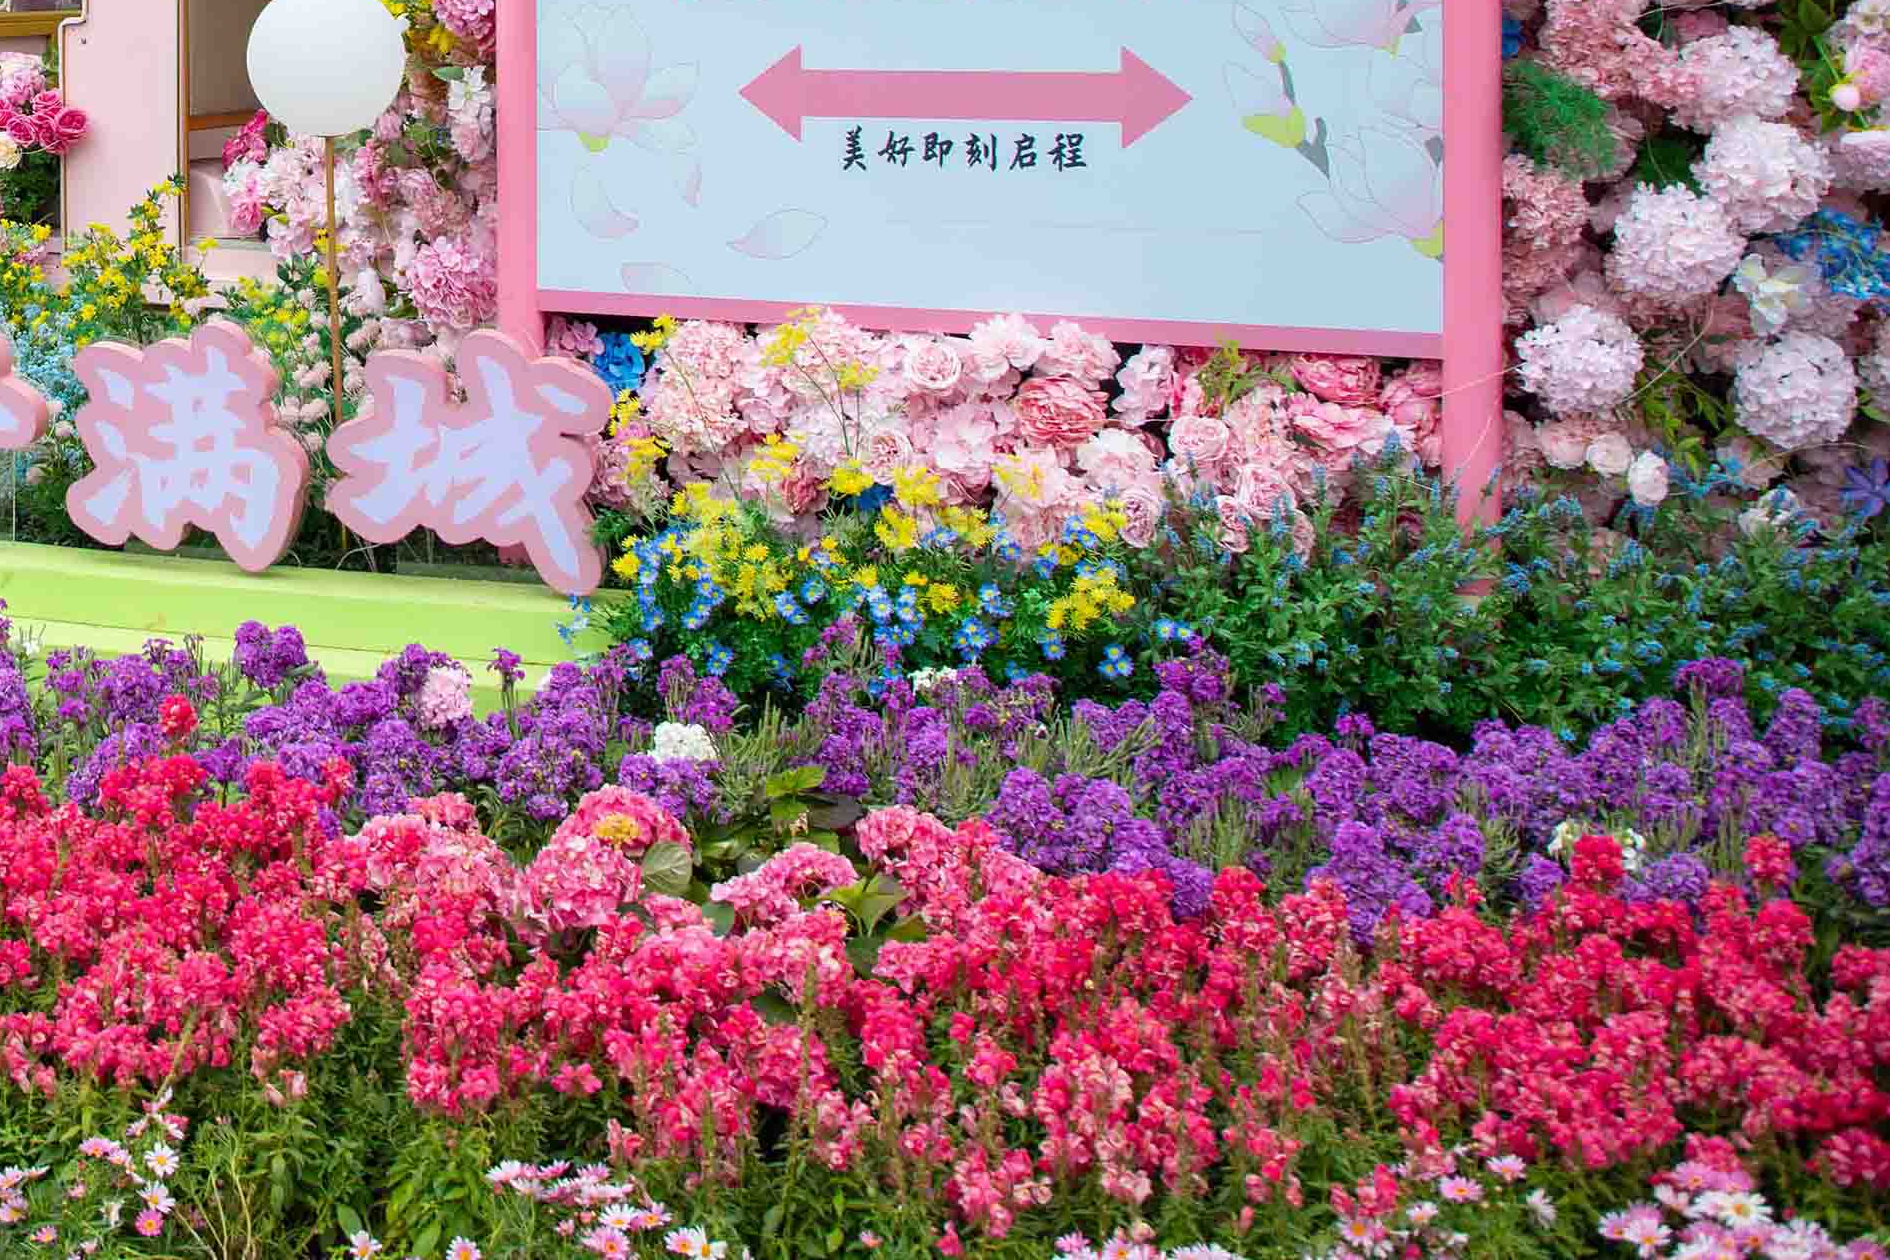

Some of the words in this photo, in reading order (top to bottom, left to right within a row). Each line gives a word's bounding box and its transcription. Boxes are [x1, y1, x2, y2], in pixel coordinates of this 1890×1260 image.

[841, 126, 1087, 172] 美好即刻启程
